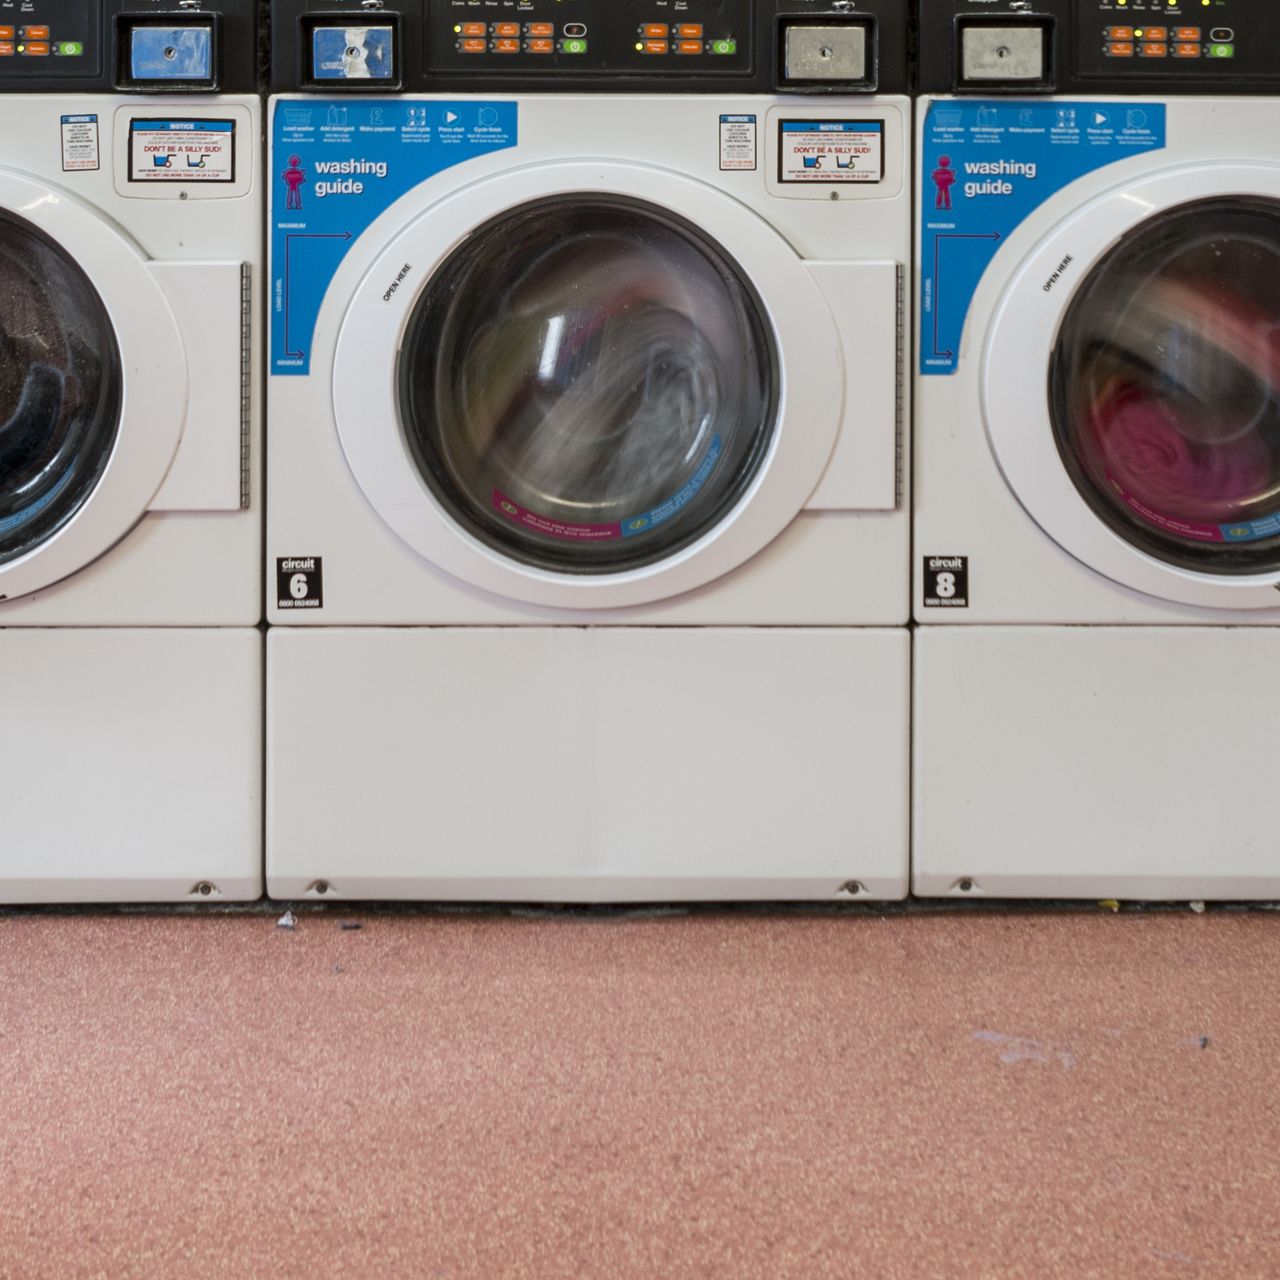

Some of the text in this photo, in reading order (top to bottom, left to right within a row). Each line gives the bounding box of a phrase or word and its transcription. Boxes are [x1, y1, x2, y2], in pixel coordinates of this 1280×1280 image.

[314, 158, 388, 178] washing
[964, 159, 1037, 180] washing
[314, 178, 364, 197] guide
[964, 179, 1013, 198] guide
[382, 263, 412, 302] OPEN HERE
[1042, 254, 1073, 293] OPEN HERE
[282, 558, 315, 569] circuit
[930, 557, 963, 568] circuit
[290, 573, 308, 599] 6
[936, 573, 955, 598] 8
